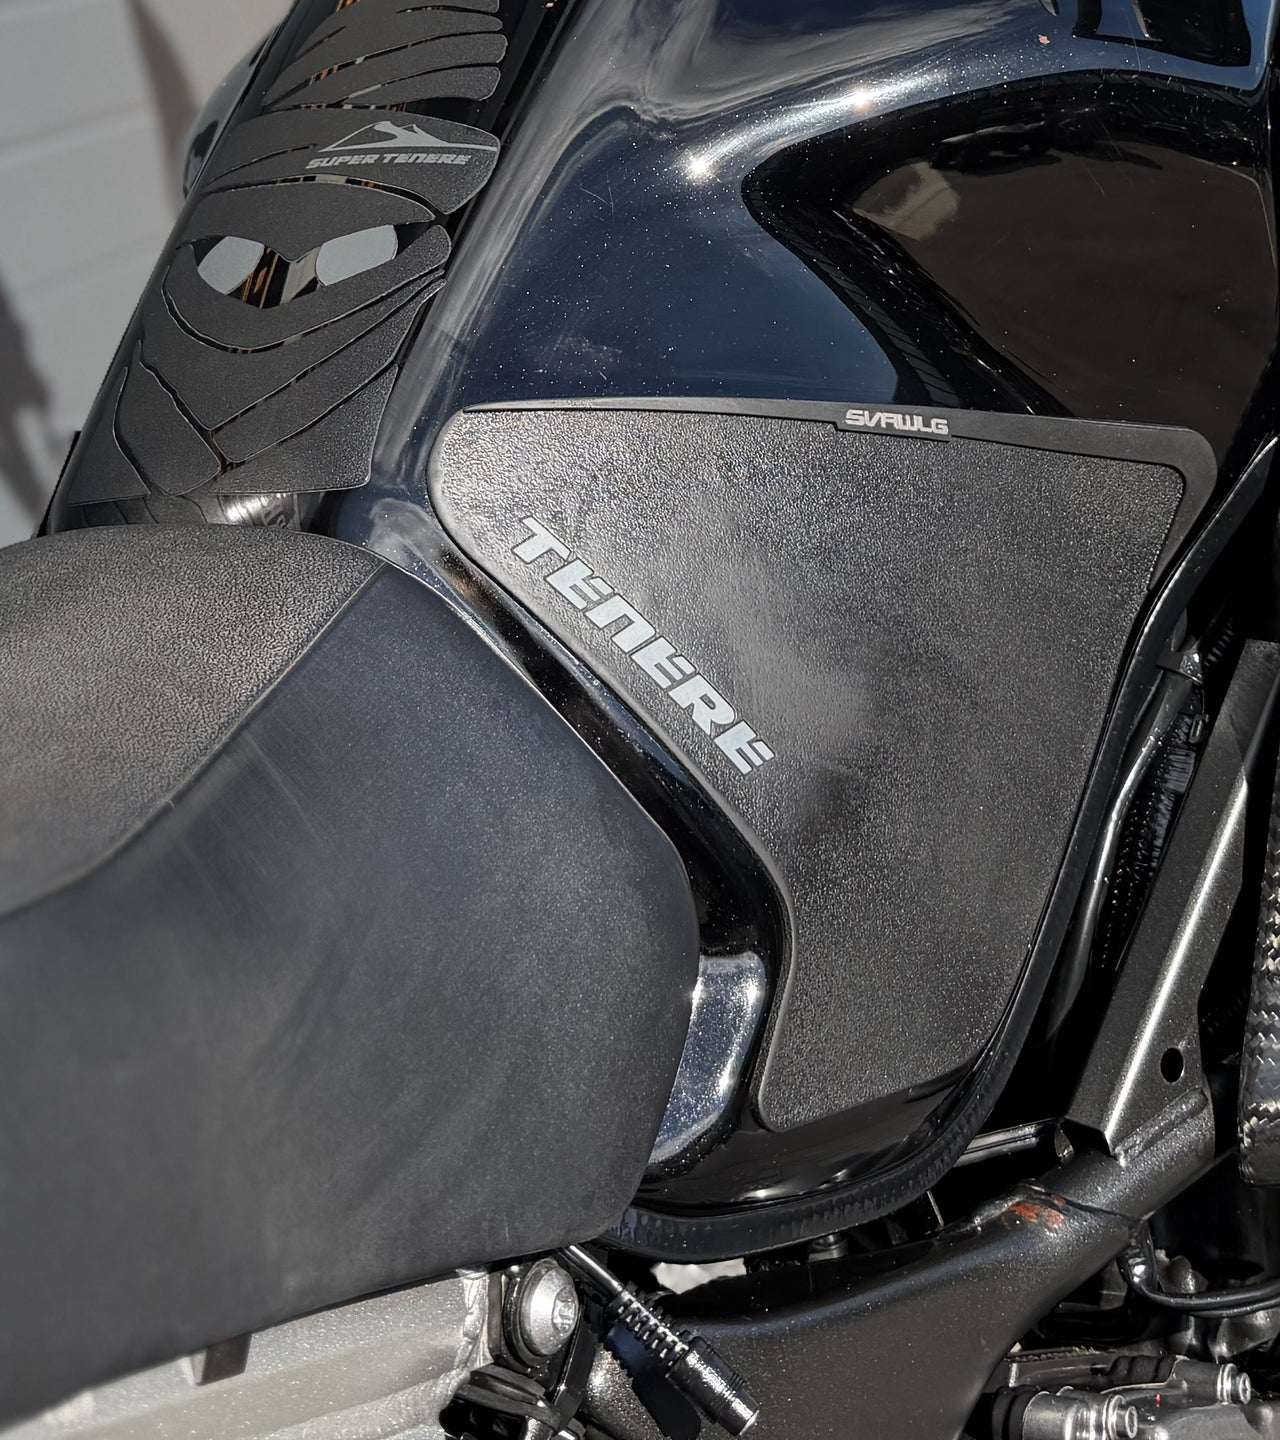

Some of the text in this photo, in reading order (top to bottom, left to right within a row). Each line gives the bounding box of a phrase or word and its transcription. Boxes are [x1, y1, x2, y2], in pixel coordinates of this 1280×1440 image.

[306, 154, 471, 169] SUPER TENERE
[511, 516, 775, 775] TENERE
